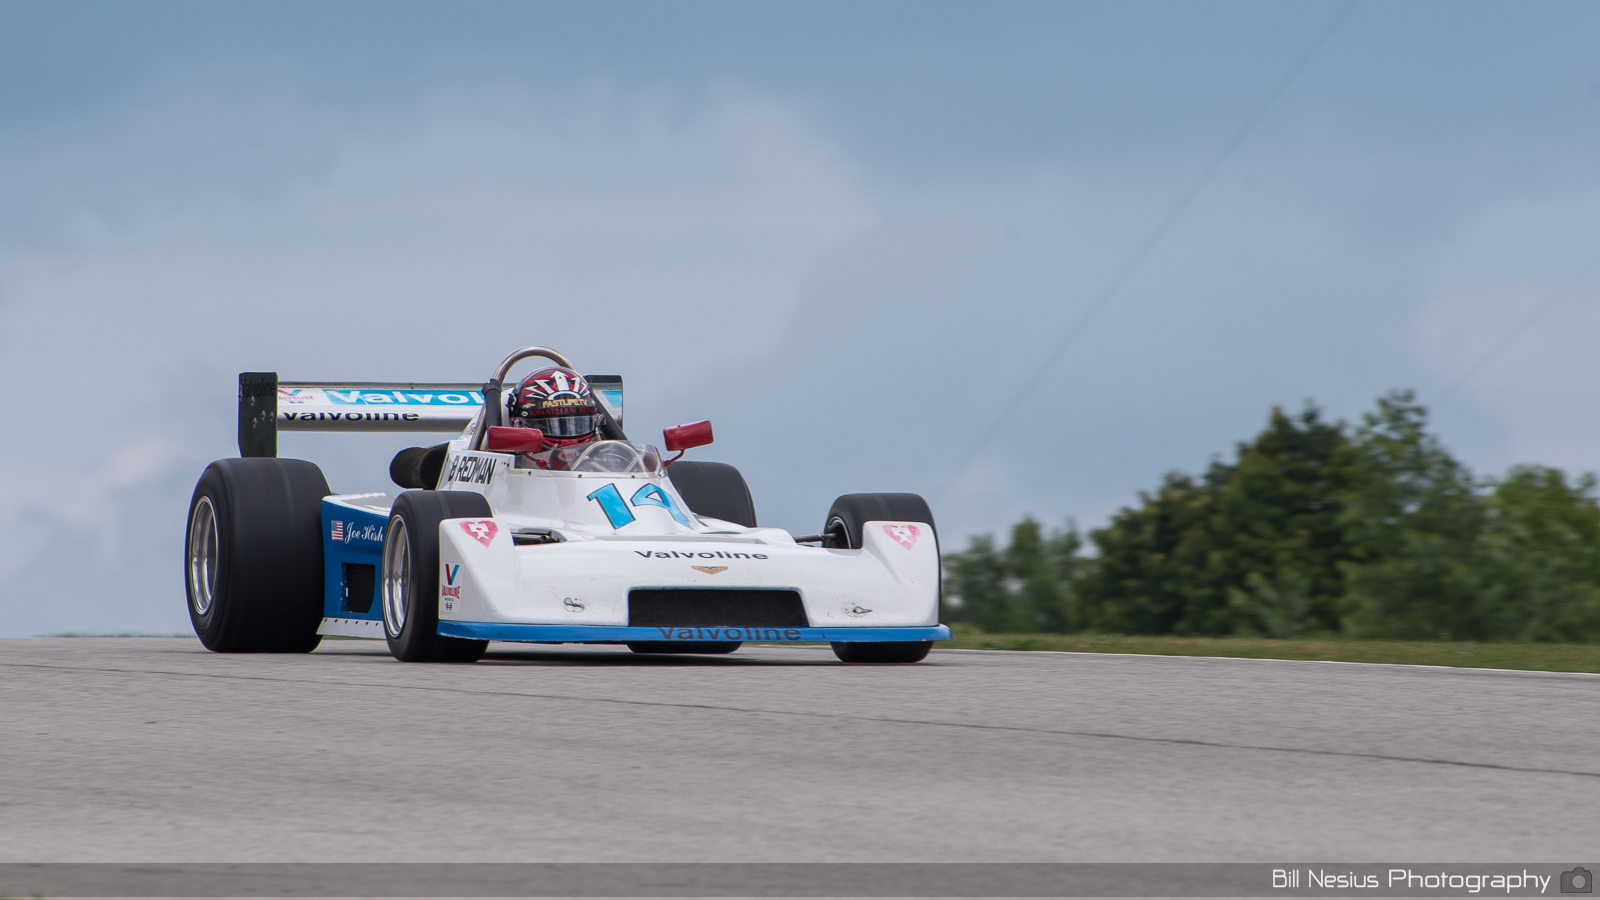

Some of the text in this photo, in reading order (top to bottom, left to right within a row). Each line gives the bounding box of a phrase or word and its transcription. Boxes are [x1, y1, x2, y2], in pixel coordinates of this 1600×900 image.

[326, 390, 485, 404] Valvol
[529, 406, 576, 416] JONATHAN
[447, 455, 497, 485] B REDMAN
[586, 482, 695, 530] 14
[344, 521, 361, 545] Joe
[633, 550, 769, 560] Valvoline
[656, 627, 802, 641] Valvoline
